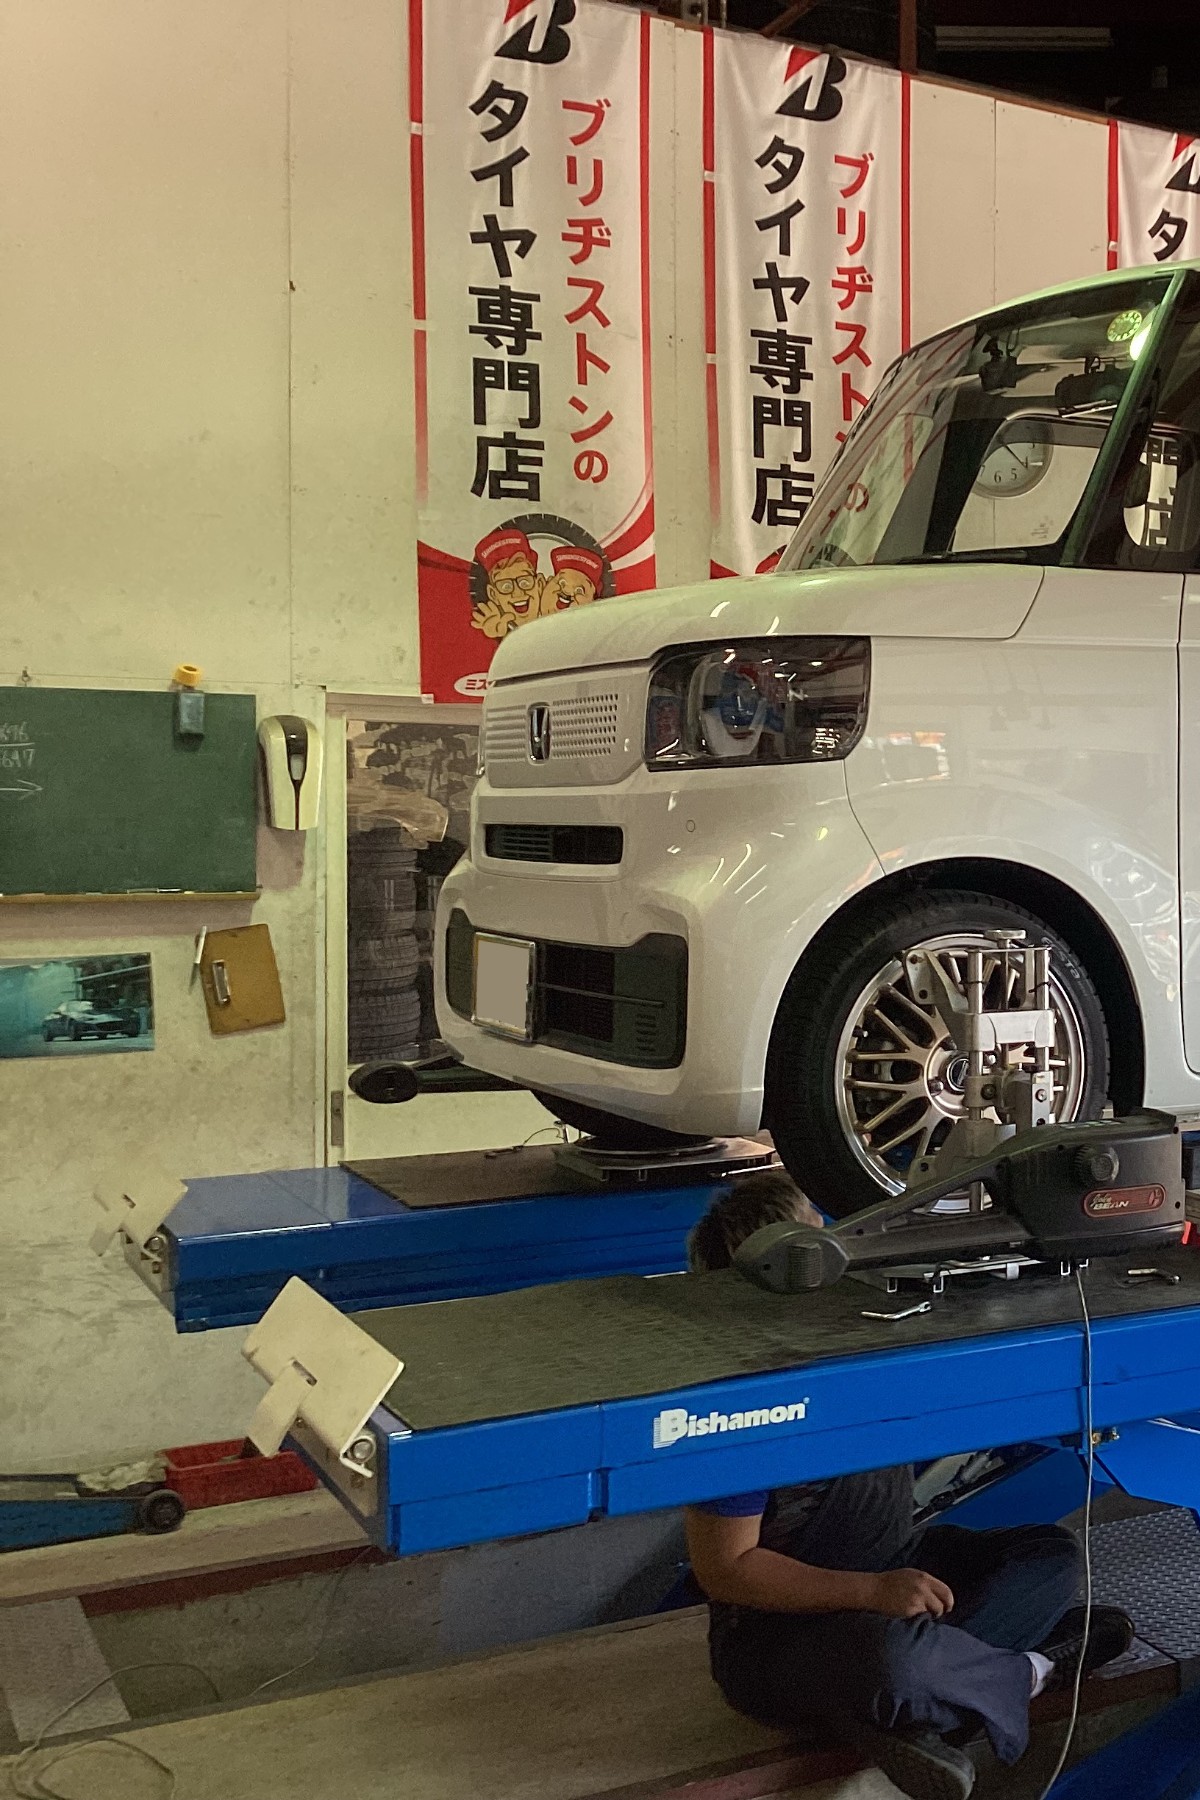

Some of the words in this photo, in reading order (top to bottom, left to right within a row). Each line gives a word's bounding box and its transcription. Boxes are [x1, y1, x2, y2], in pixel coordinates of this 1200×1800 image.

[468, 79, 545, 502] タイヤ専門店
[561, 97, 612, 484] ブリヂストンの
[749, 134, 814, 528] タイヤ専門店
[1093, 1200, 1130, 1210] BEAN
[653, 1401, 807, 1449] Bishamon
